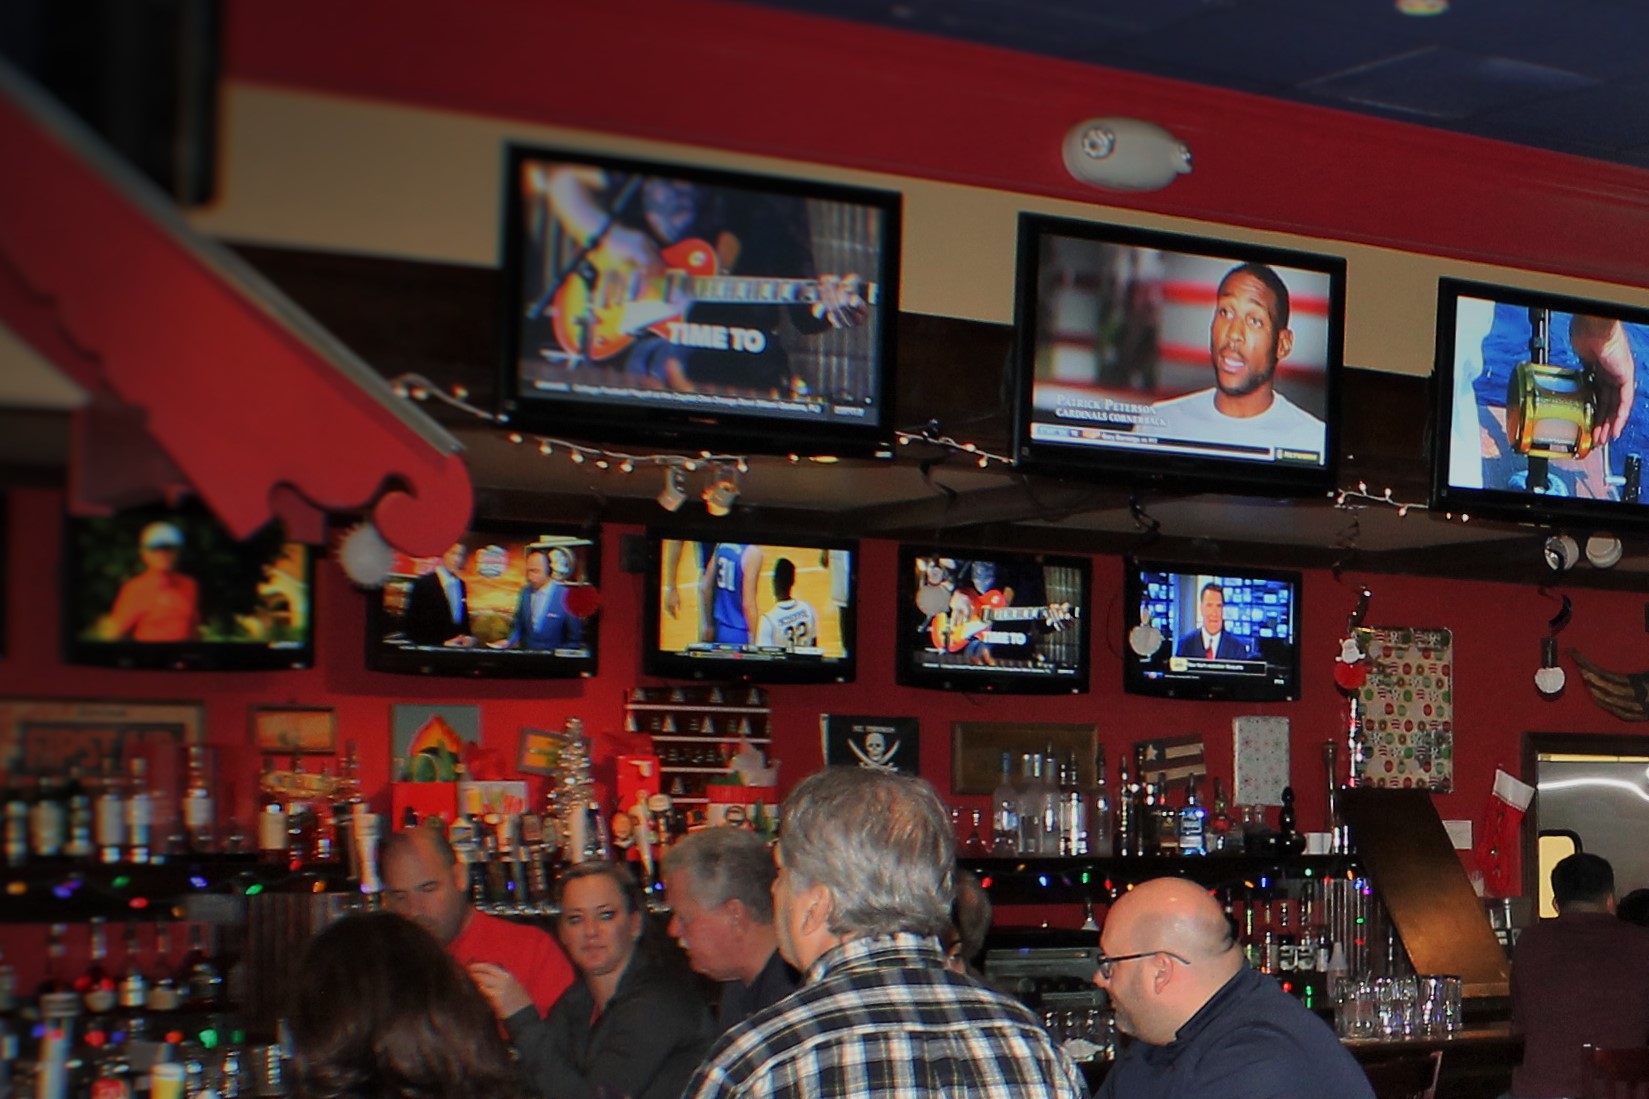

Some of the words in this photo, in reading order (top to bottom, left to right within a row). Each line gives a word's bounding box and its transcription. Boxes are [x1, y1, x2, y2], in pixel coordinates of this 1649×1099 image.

[667, 323, 728, 350] TIME
[728, 326, 766, 354] TO
[1055, 407, 1107, 422] CARDINALS
[1056, 394, 1101, 410] PATRICK
[1103, 398, 1157, 414] PETERSON
[716, 557, 736, 591] 31
